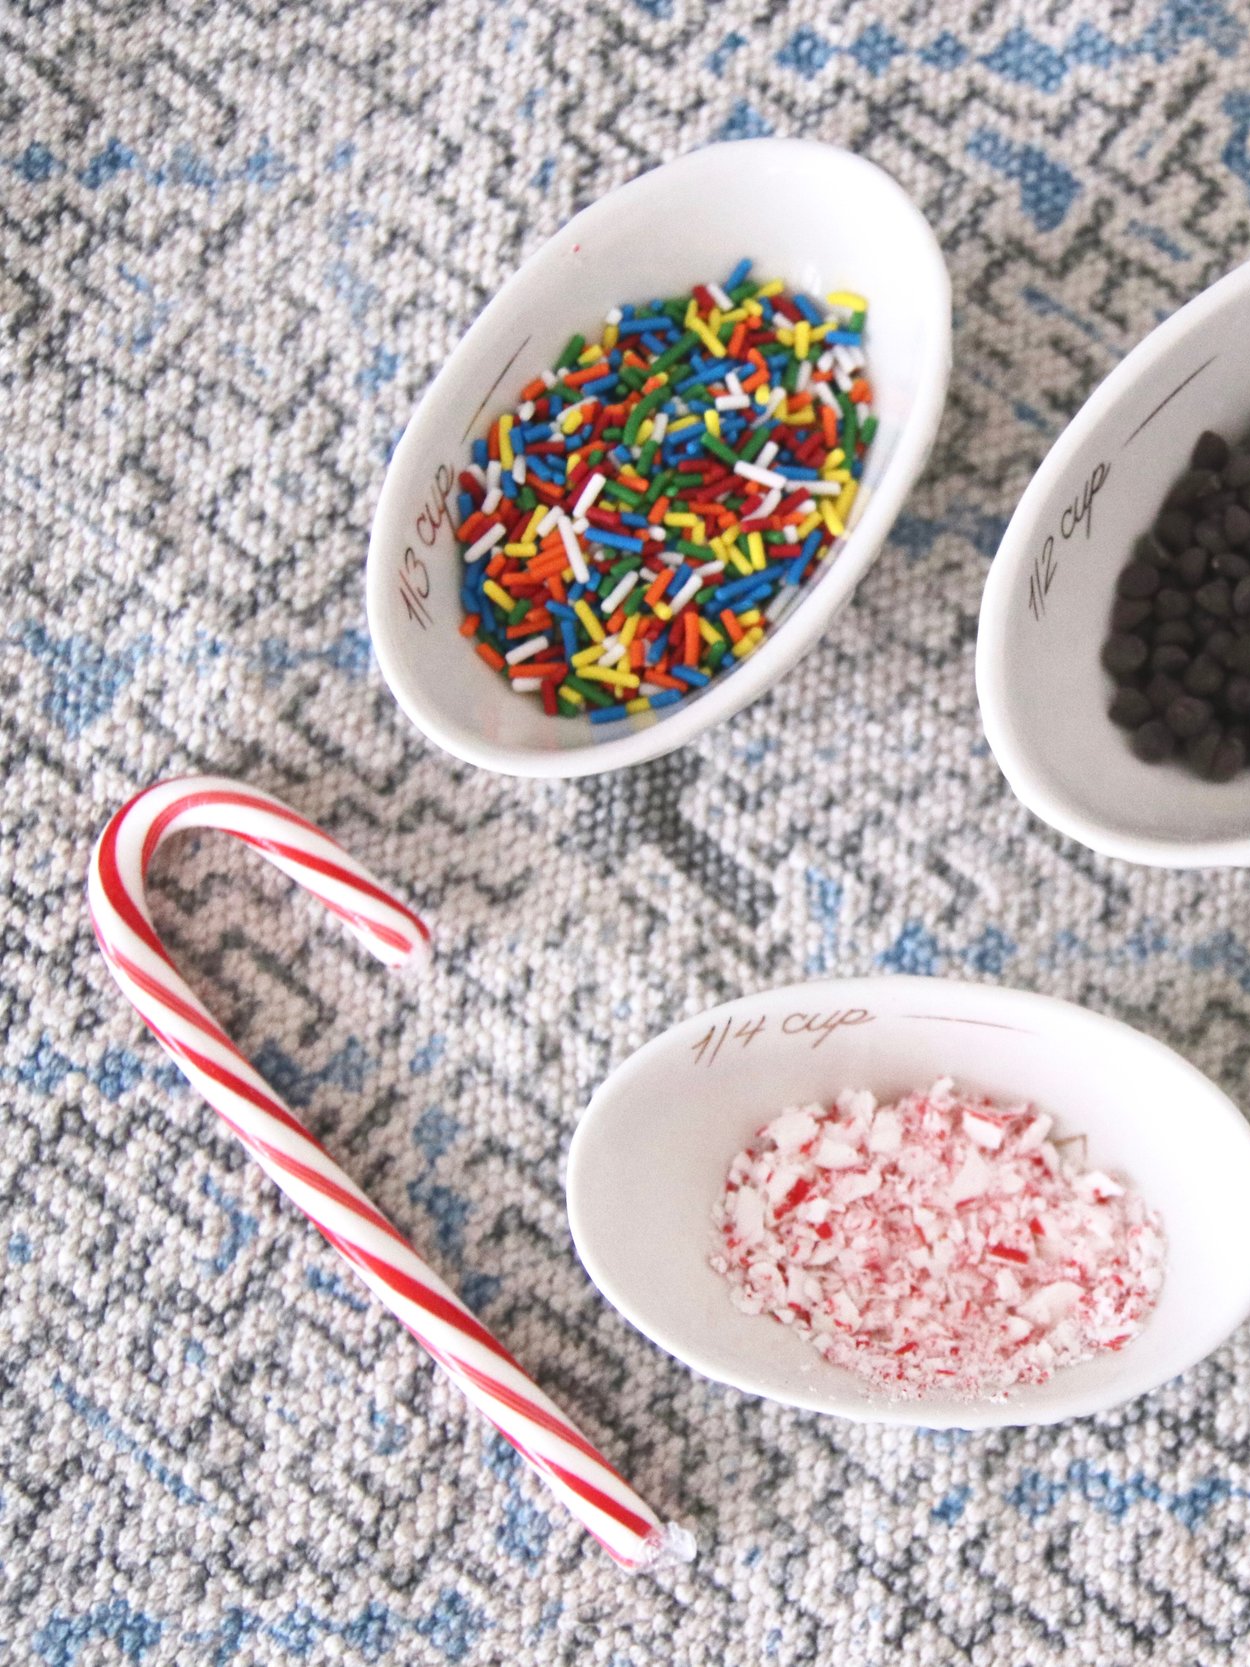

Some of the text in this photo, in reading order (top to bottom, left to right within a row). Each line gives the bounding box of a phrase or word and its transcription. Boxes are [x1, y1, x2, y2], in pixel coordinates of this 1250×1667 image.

[399, 464, 459, 632] 1/3 cup
[1028, 462, 1111, 622] 1/2 cup
[691, 1008, 876, 1068] 1/4 cup
